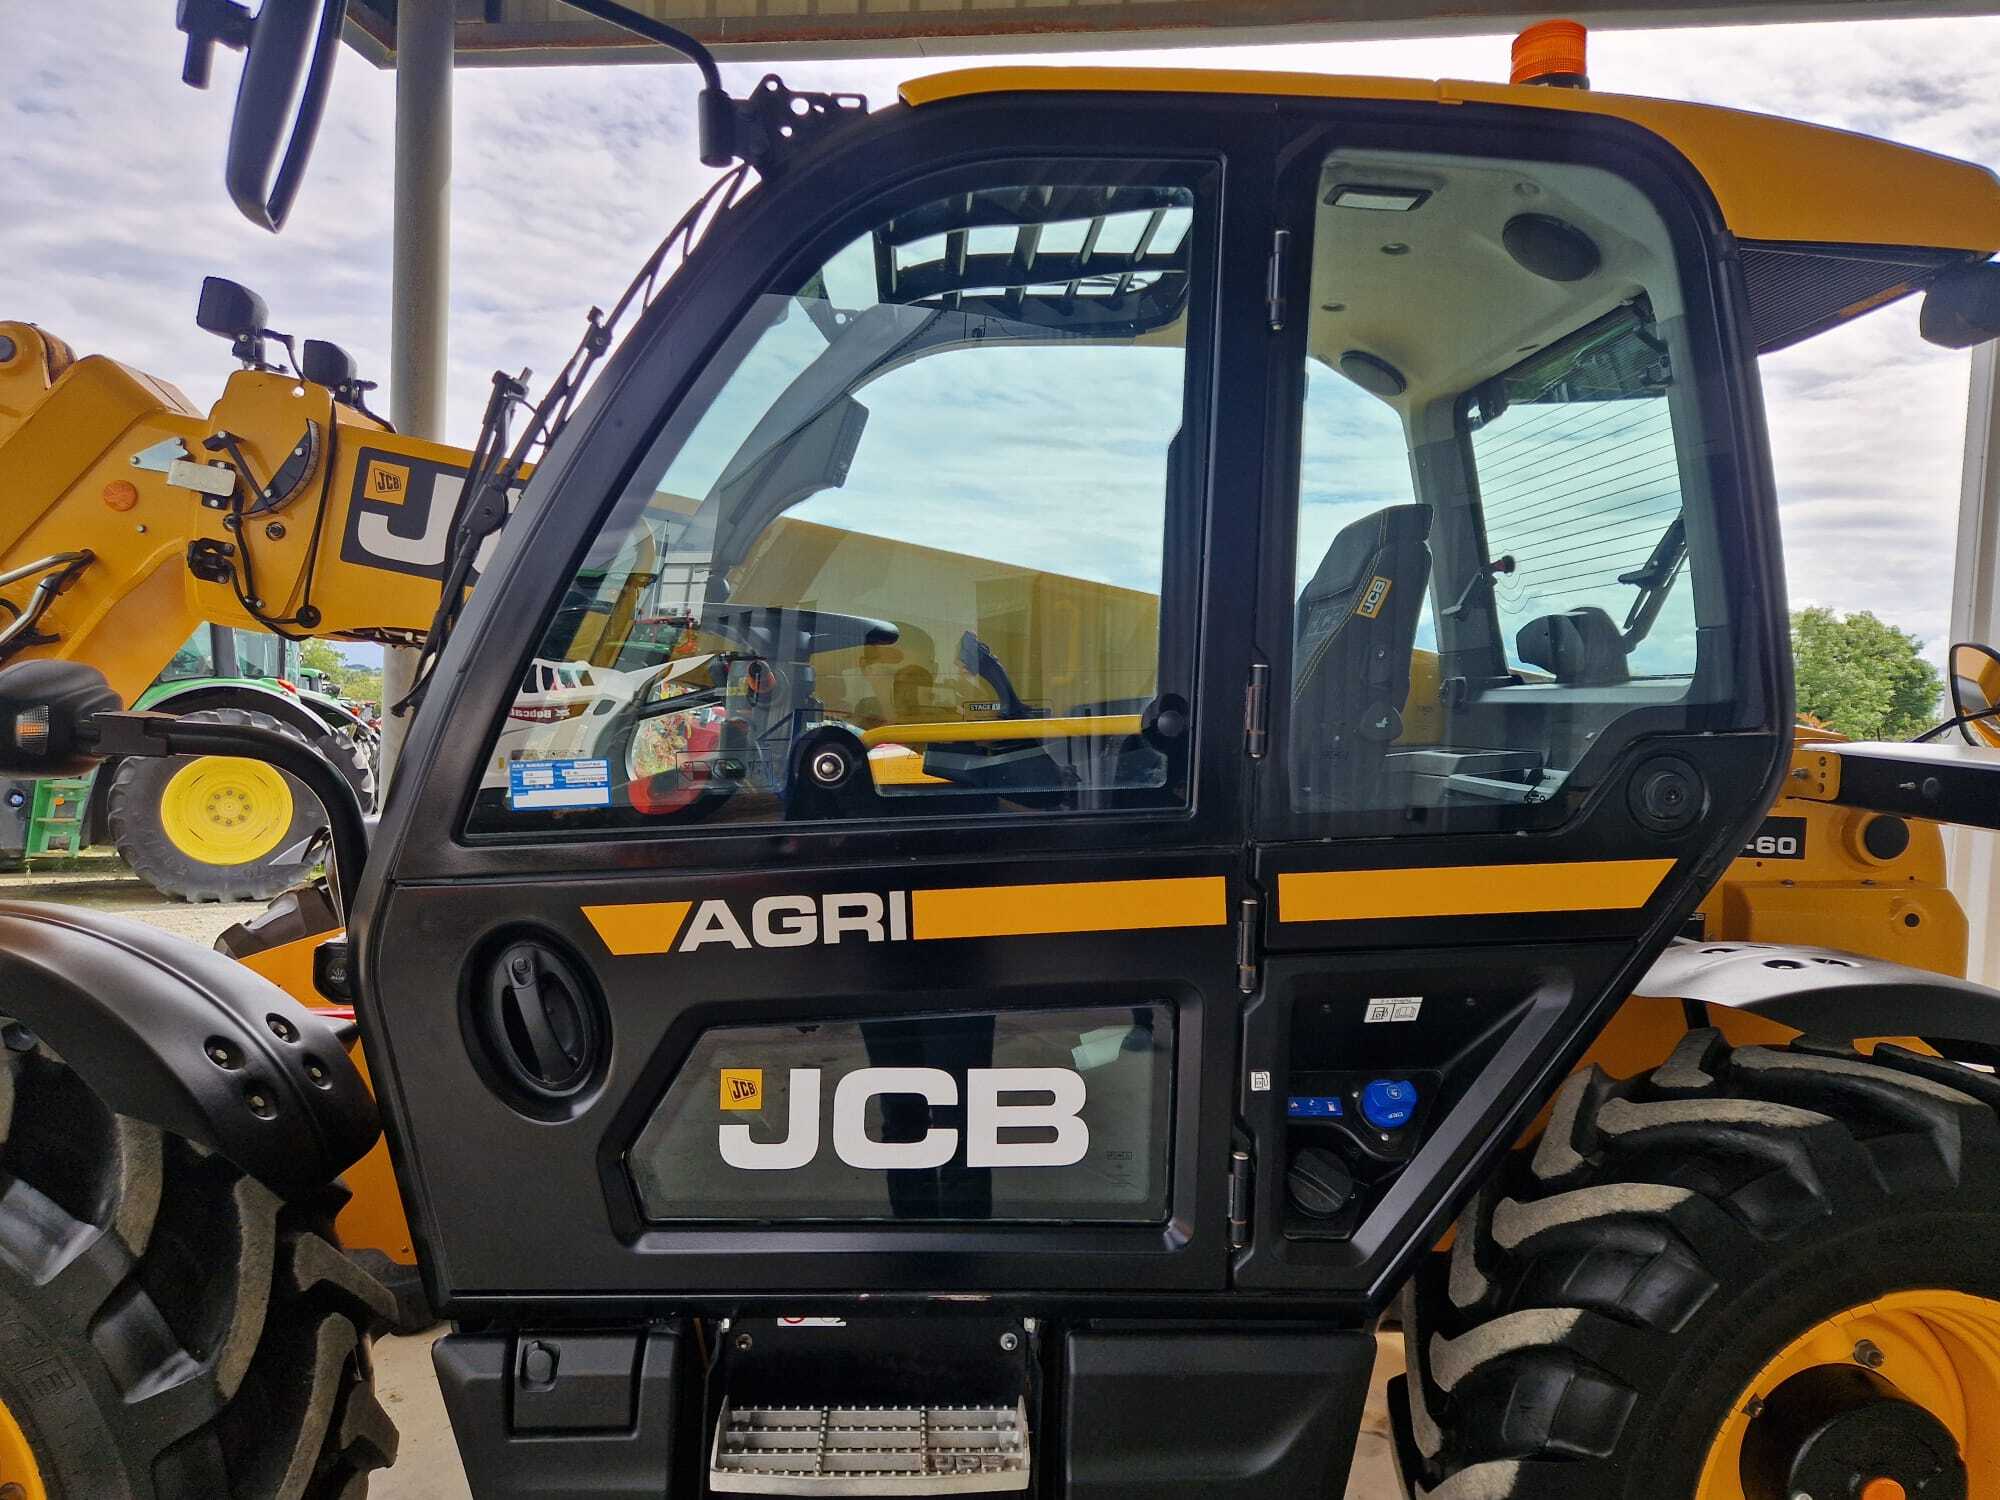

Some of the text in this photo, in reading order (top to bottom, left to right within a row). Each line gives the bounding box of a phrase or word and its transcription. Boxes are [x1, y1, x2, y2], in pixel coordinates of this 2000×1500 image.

[377, 470, 401, 491] JCB
[1365, 580, 1386, 613] JCB
[678, 891, 906, 952] AGRI
[731, 1079, 757, 1099] JCB
[719, 1067, 1090, 1169] JCB
